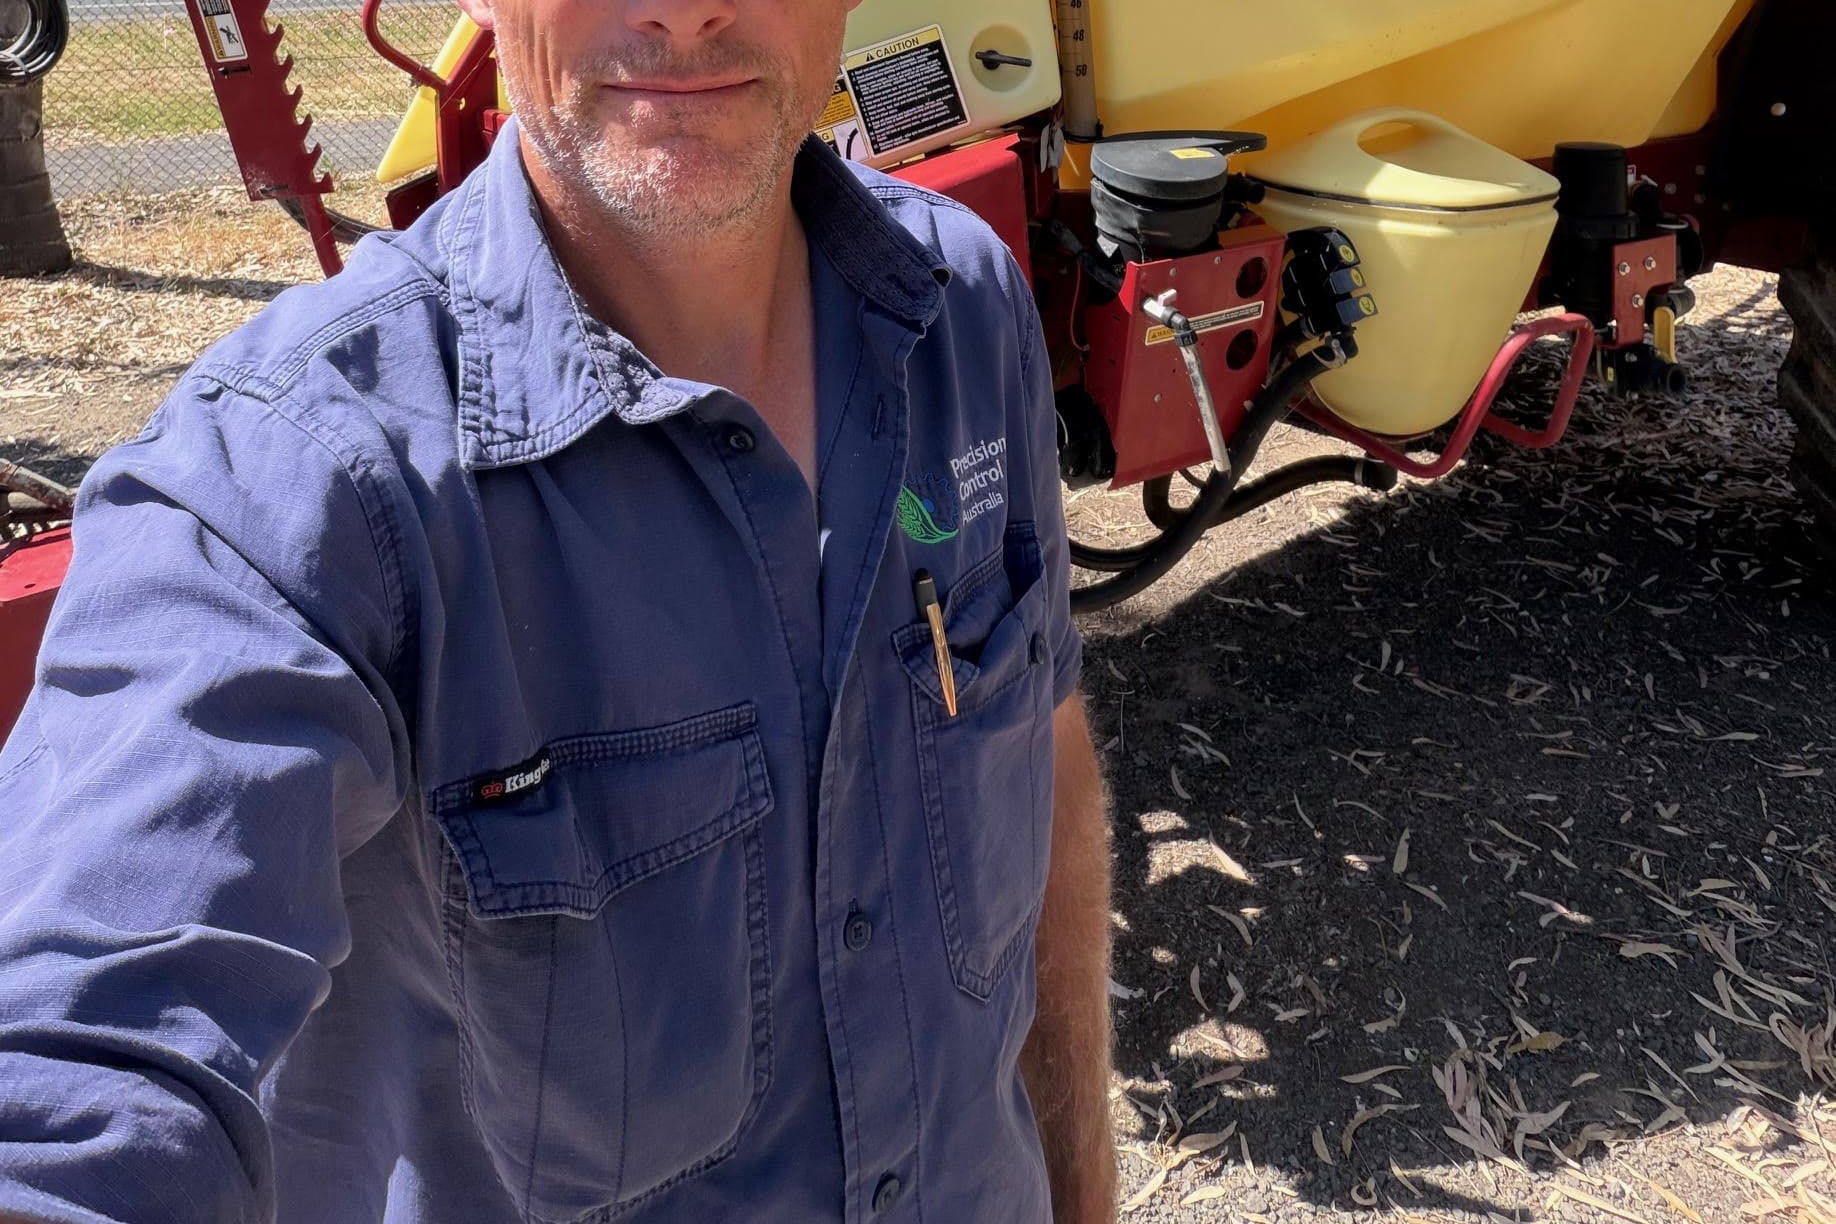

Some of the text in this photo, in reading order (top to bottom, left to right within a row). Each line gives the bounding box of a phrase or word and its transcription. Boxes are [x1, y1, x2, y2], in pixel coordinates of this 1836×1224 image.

[876, 37, 920, 58] CAUTION
[1073, 29, 1084, 42] 48
[1075, 64, 1087, 76] 50
[950, 436, 1006, 478] Precision
[959, 460, 1004, 500] Control
[962, 491, 1004, 527] Australia
